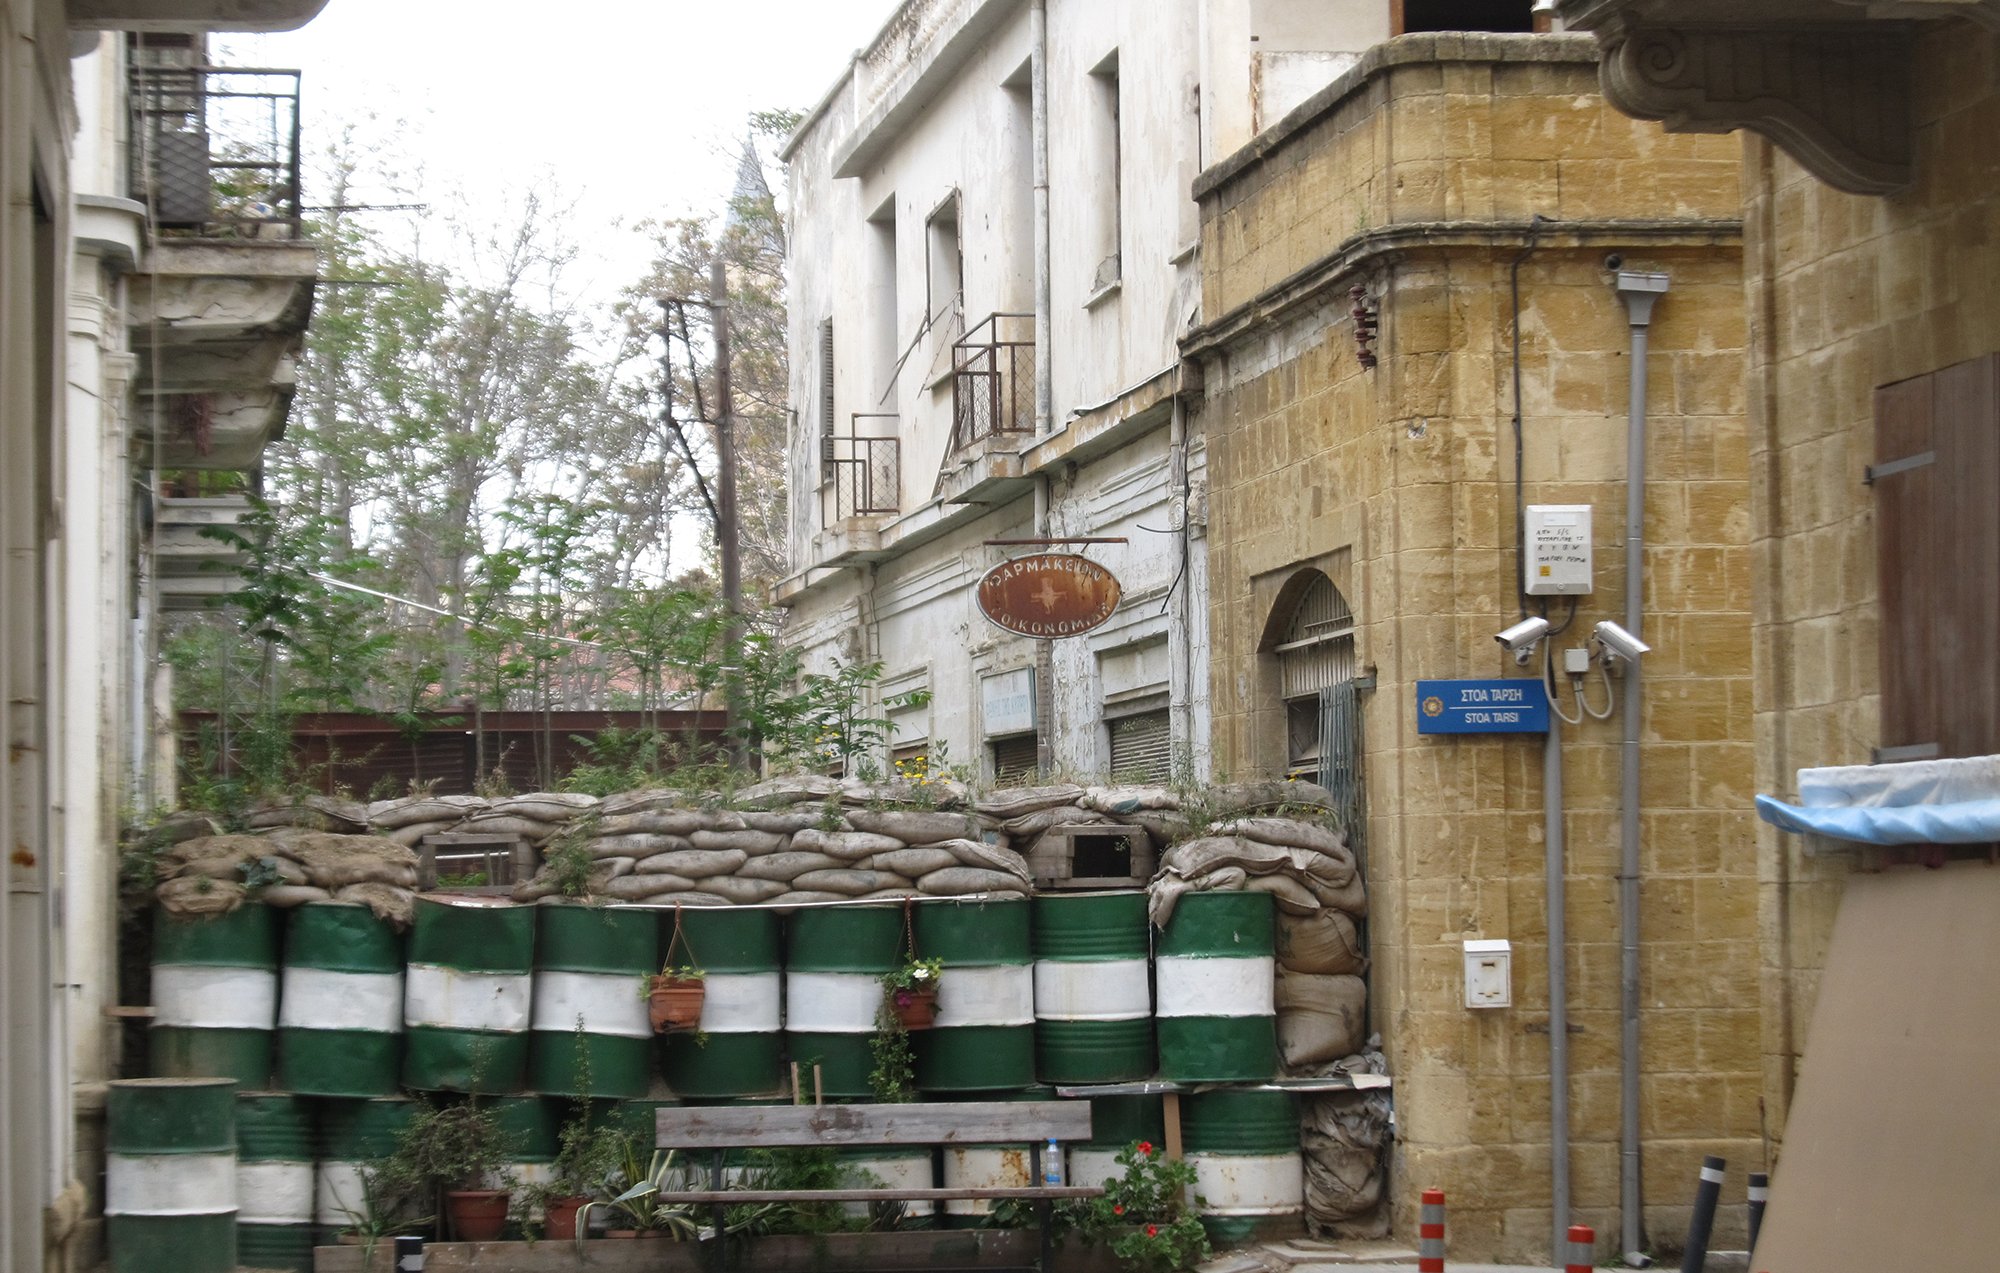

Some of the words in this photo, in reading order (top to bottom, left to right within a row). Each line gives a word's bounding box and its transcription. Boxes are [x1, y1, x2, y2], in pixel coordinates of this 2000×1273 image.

[1461, 689, 1488, 702] ΣΤΟΑ
[1490, 689, 1522, 702] ΤΑΡΣΗ
[1465, 712, 1491, 723] STOA
[1492, 712, 1519, 723] TARSI
